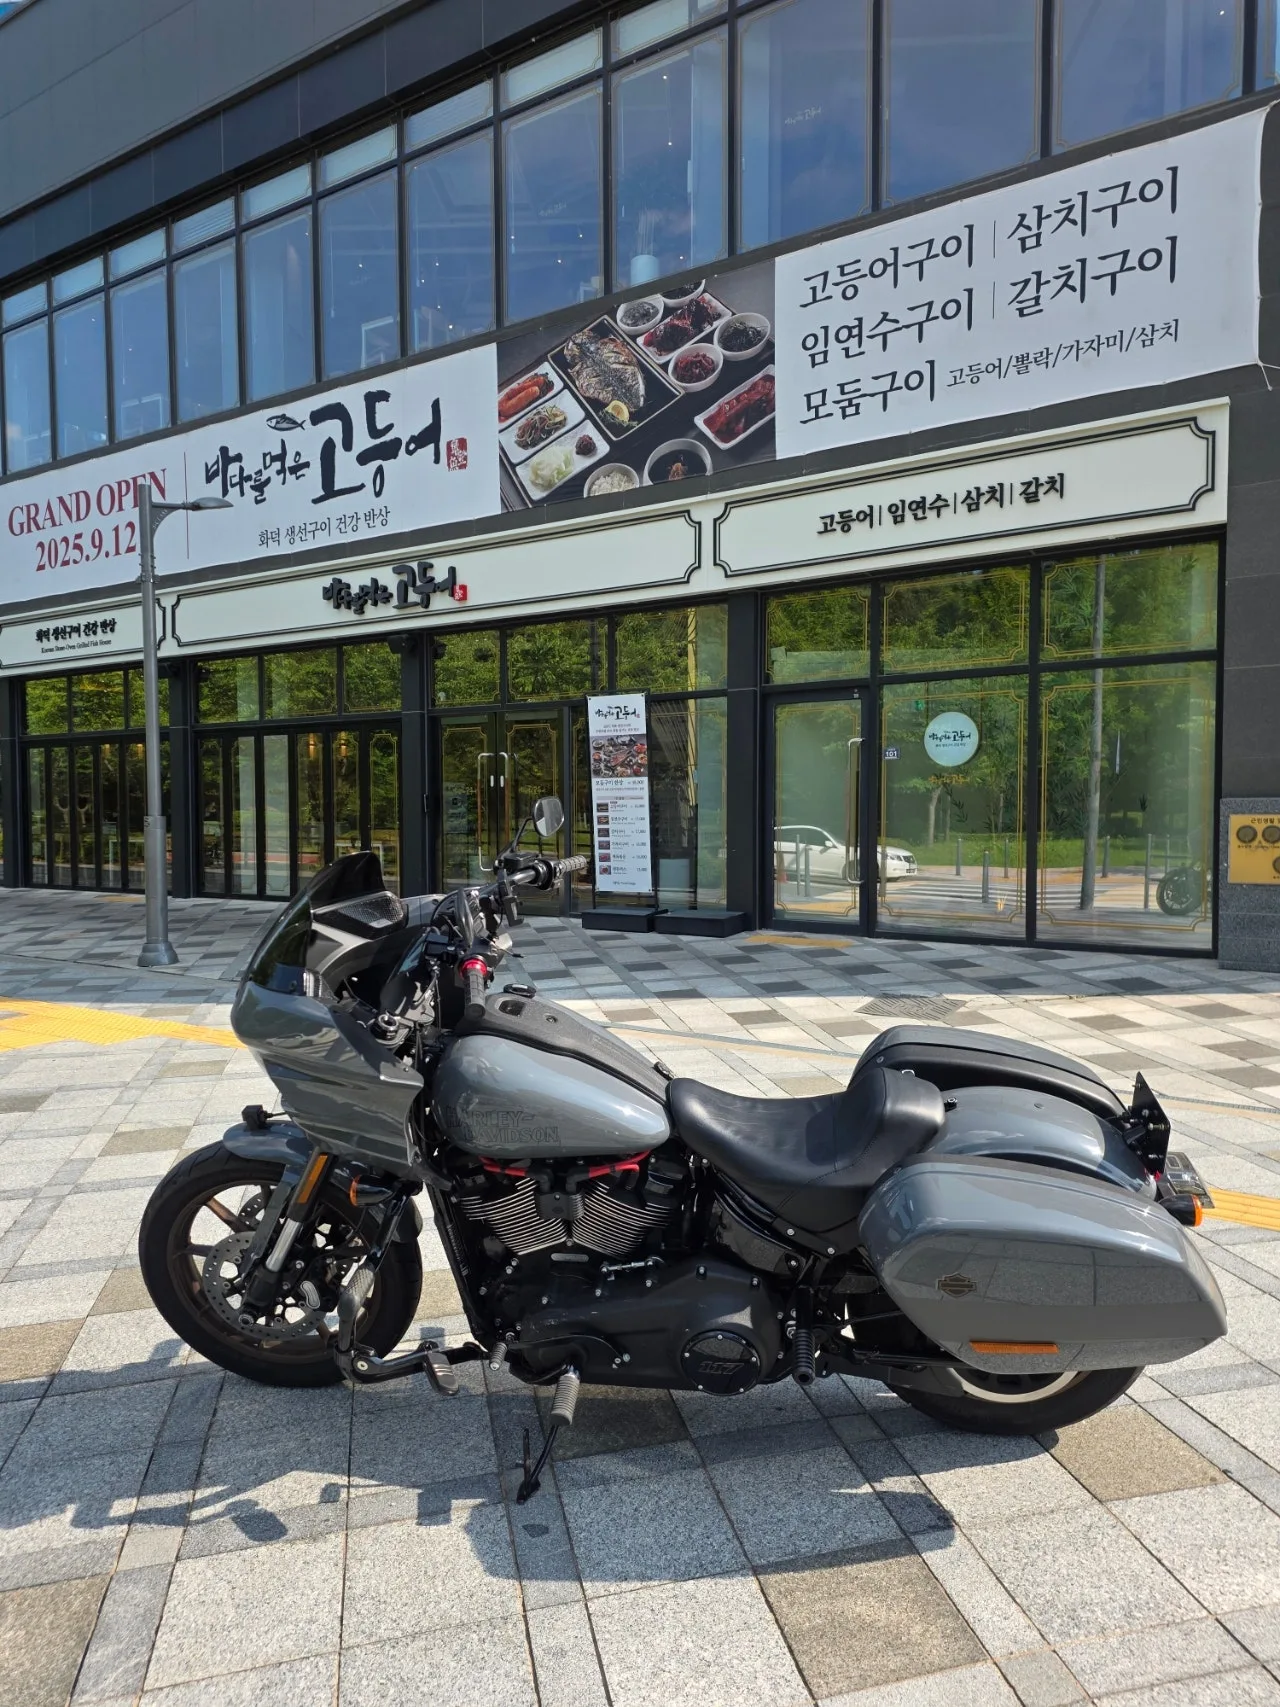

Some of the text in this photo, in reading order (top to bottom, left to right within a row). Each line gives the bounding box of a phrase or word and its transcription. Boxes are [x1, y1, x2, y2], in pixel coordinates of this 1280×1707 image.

[799, 166, 1179, 310] 고등어구이 삼치구이
[800, 236, 1178, 369] 임연수구이 갈치구이
[798, 318, 1181, 425] 모둠구이 고등어/뽈락/가자미/삼치
[205, 445, 271, 505] 바다를
[263, 438, 311, 485] 먹은
[309, 389, 442, 505] 고등어
[8, 490, 91, 537] GRAND
[258, 505, 391, 549] 화덕 생선구이 건강 반상
[816, 472, 1066, 537] 고등어 임연수 삼치 갈치
[35, 521, 137, 572] 2025.9.12
[392, 561, 457, 610] 고등어
[36, 618, 117, 643] 화덕 생선구이 건강 반상
[464, 1126, 559, 1143] DAVIDSON
